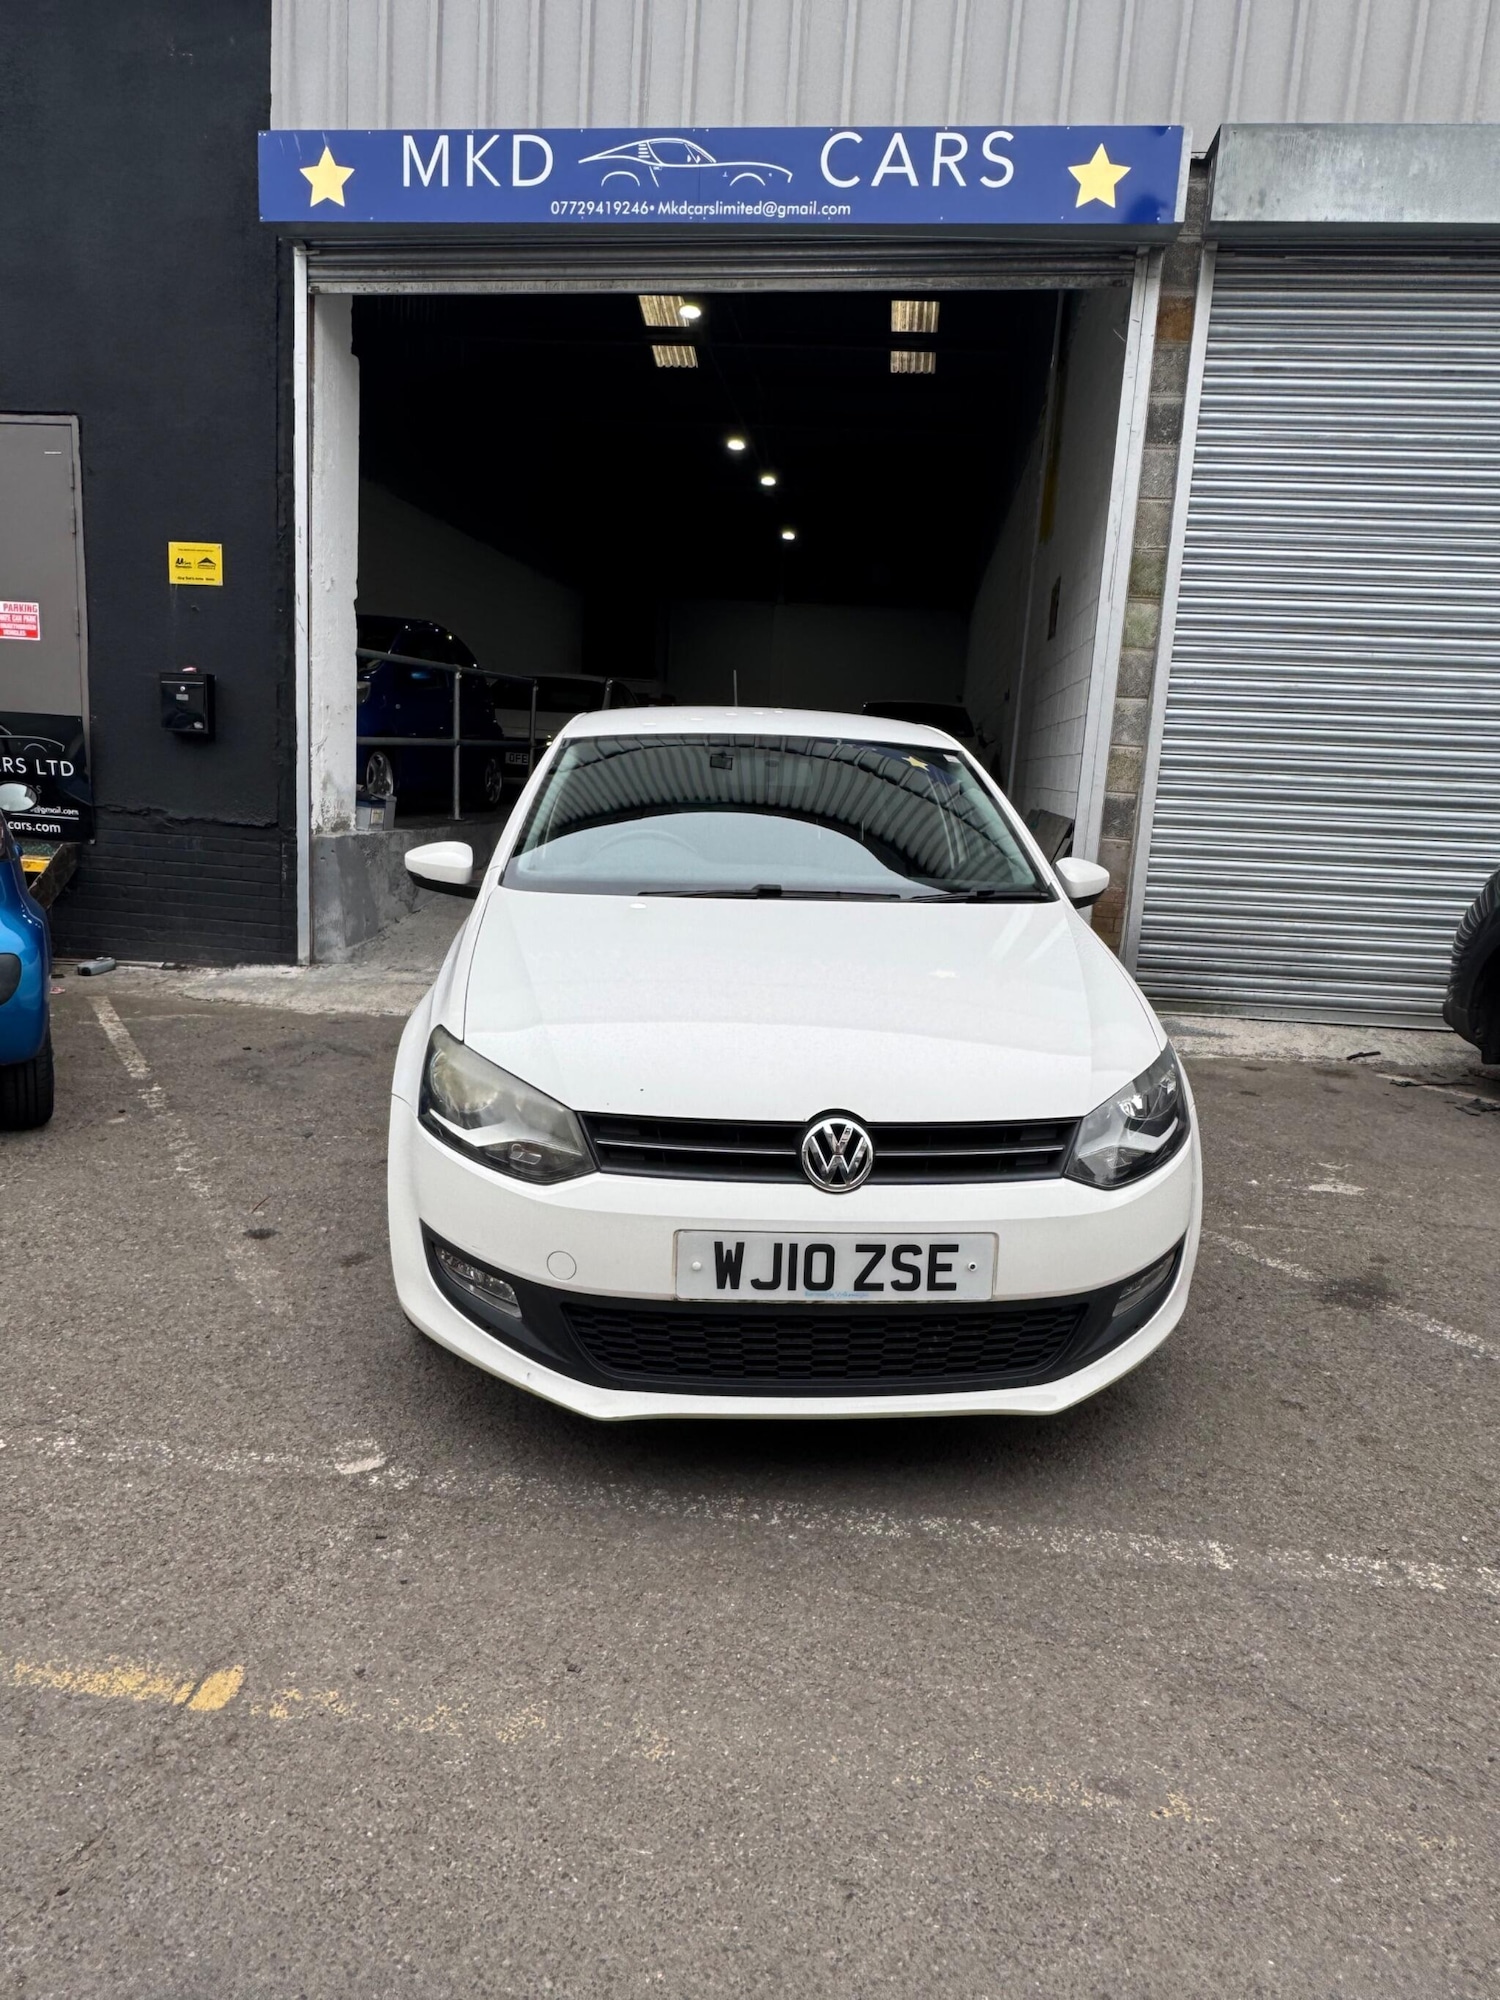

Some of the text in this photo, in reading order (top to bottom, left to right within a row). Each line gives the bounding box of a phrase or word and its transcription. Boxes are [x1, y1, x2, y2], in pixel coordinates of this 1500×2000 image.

[403, 130, 1015, 188] MKD CARS
[657, 200, 851, 218] Mkdcarslimited@gmail.com
[3, 603, 38, 613] PARKING
[0, 757, 74, 776] RS LTD
[714, 1241, 959, 1291] WJ10 ZSE
